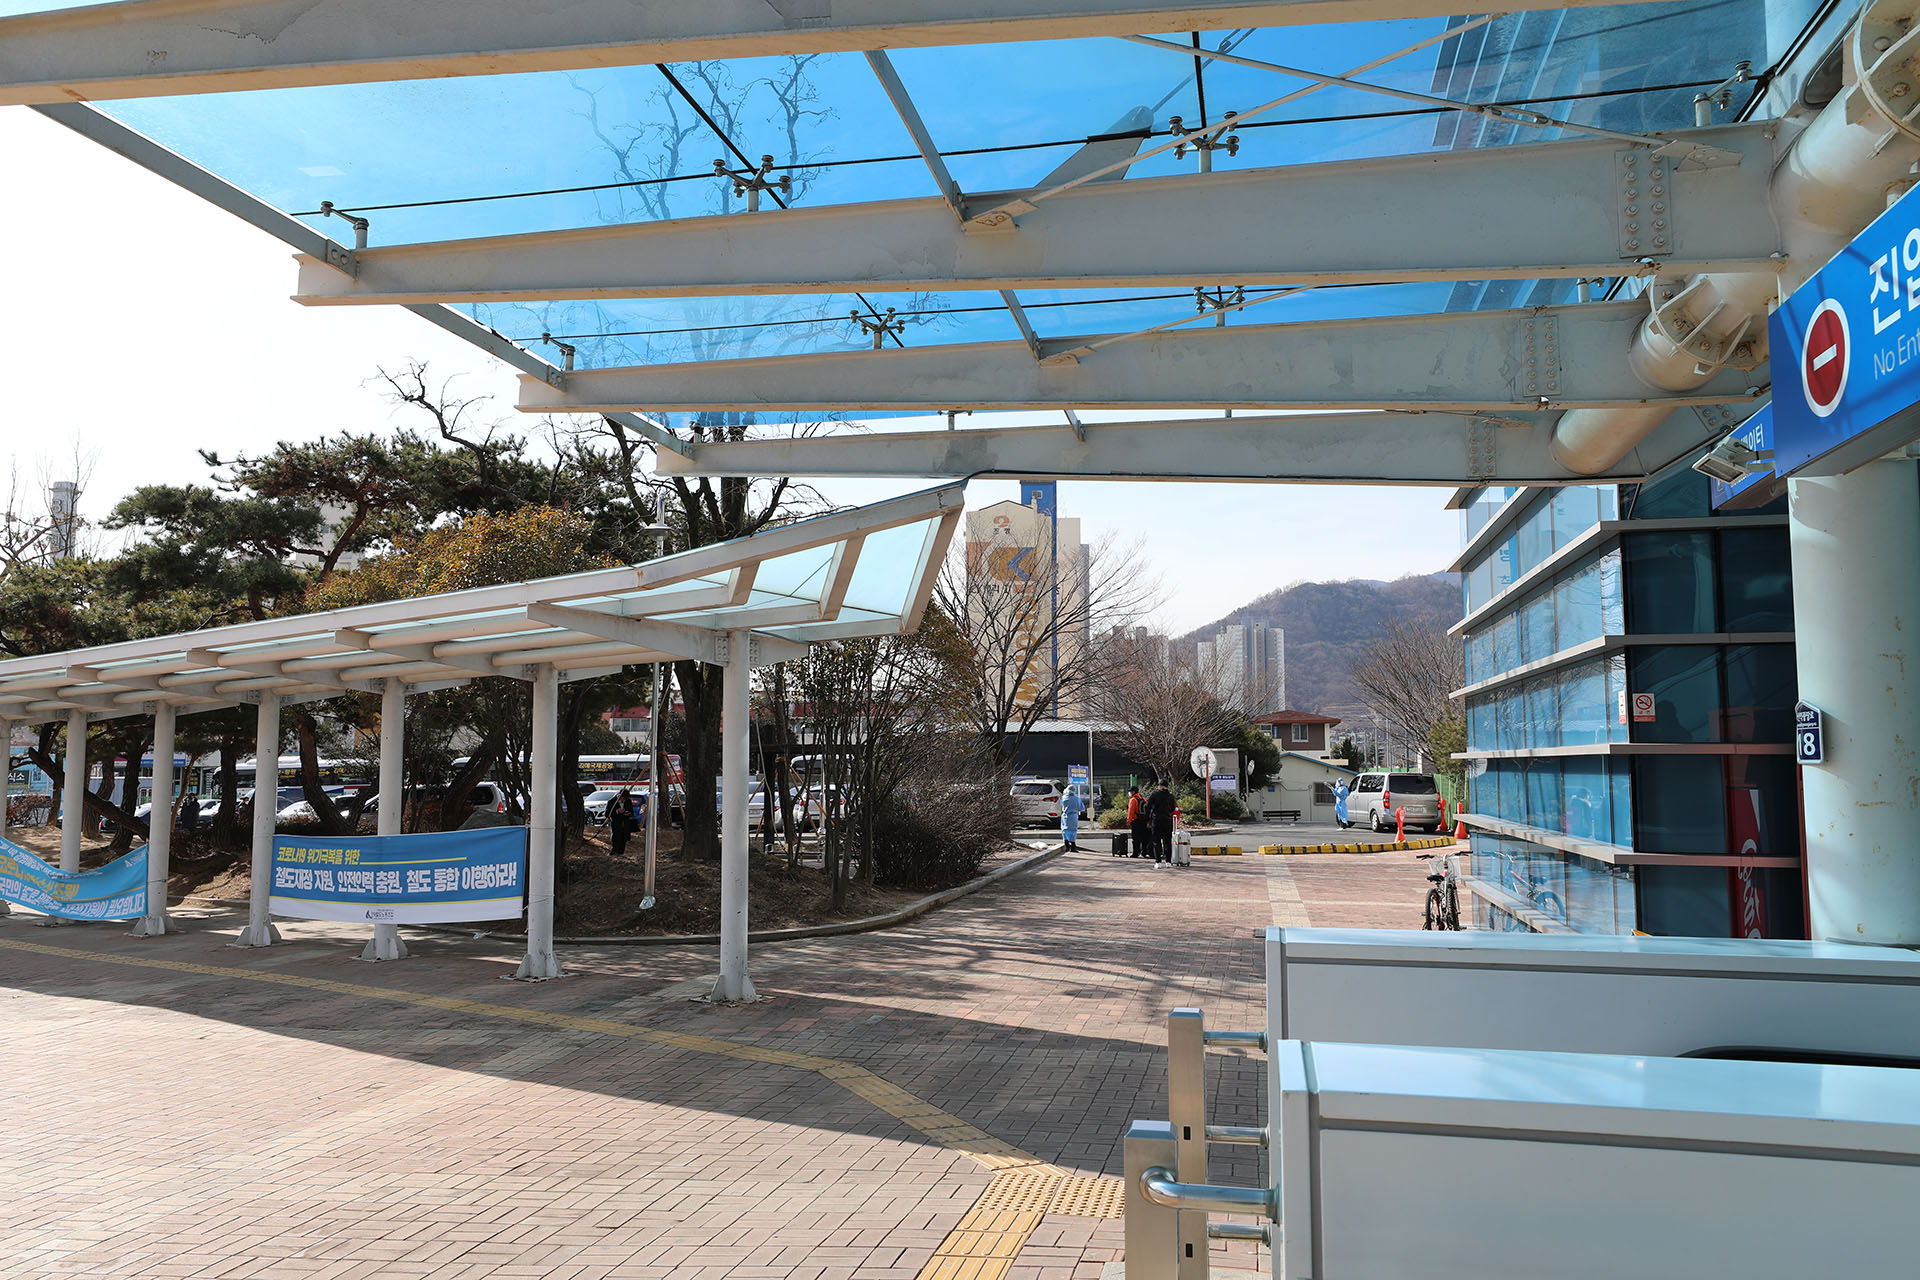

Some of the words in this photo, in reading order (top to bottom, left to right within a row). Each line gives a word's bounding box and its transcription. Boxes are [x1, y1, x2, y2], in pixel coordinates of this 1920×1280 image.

[1873, 347, 1895, 381] No
[276, 847, 307, 862] 코로나19
[307, 848, 343, 865] 위기극복을
[344, 849, 361, 866] 위한
[275, 867, 313, 891] 철도재정
[314, 870, 335, 893] 지원,
[337, 871, 375, 894] 안전인력
[376, 870, 403, 894] 충원,
[406, 870, 431, 892] 철도
[433, 867, 459, 892] 통합
[461, 862, 517, 890] 이행하라!
